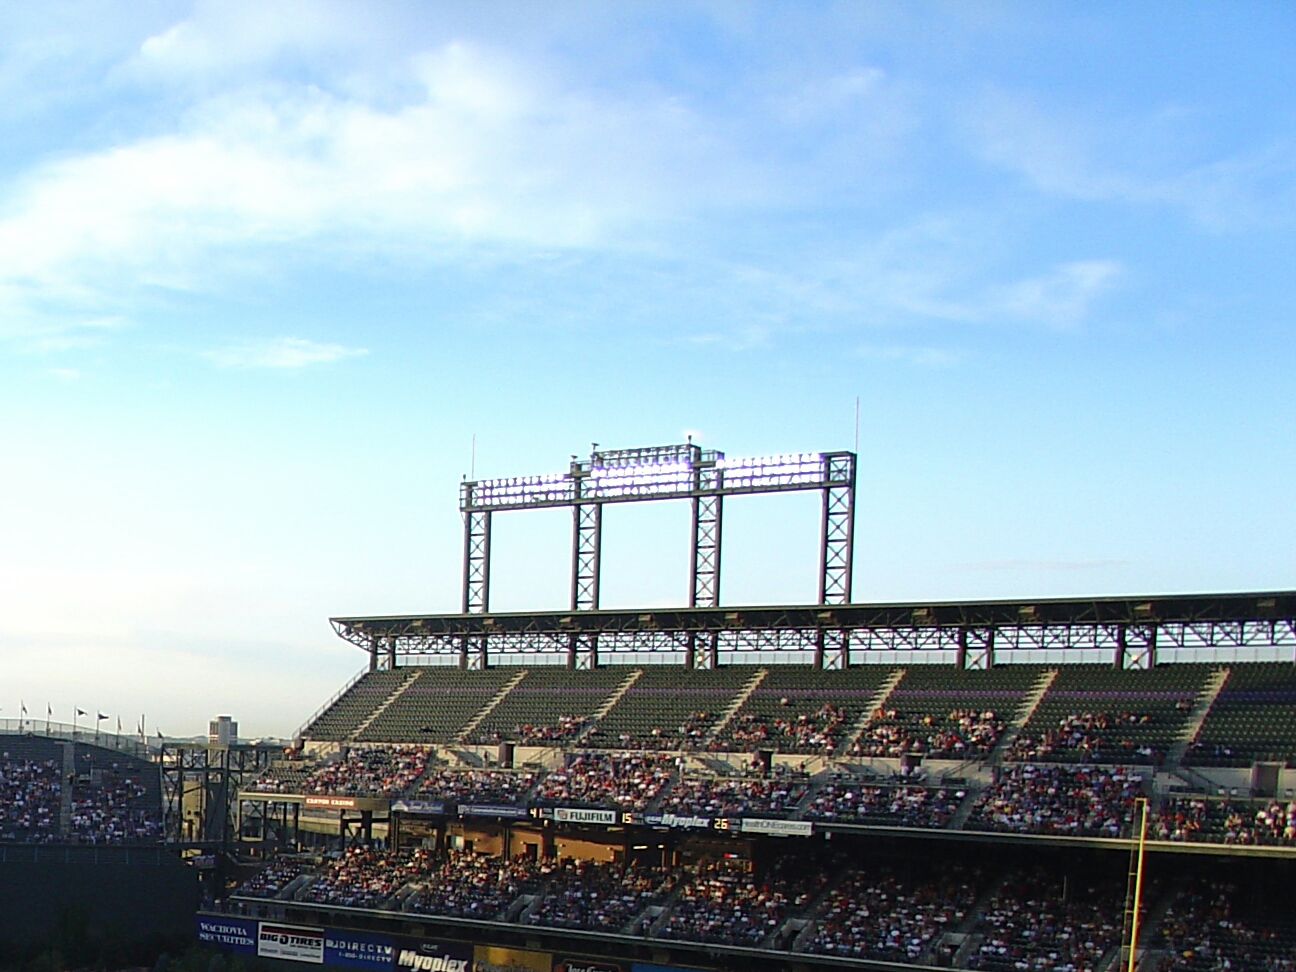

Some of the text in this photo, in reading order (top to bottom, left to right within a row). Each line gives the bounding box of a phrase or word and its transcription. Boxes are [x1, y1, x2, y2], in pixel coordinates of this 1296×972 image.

[569, 811, 613, 822] FUJIFILM
[622, 813, 632, 824] 15
[661, 814, 710, 828] Myoplex
[714, 818, 728, 829] 26
[199, 922, 248, 936] WACHOVIA
[199, 933, 254, 946] SECURITIES
[260, 933, 279, 942] BIG
[279, 934, 289, 945] O
[289, 936, 322, 947] TIRES
[339, 940, 393, 955] DIRECTV
